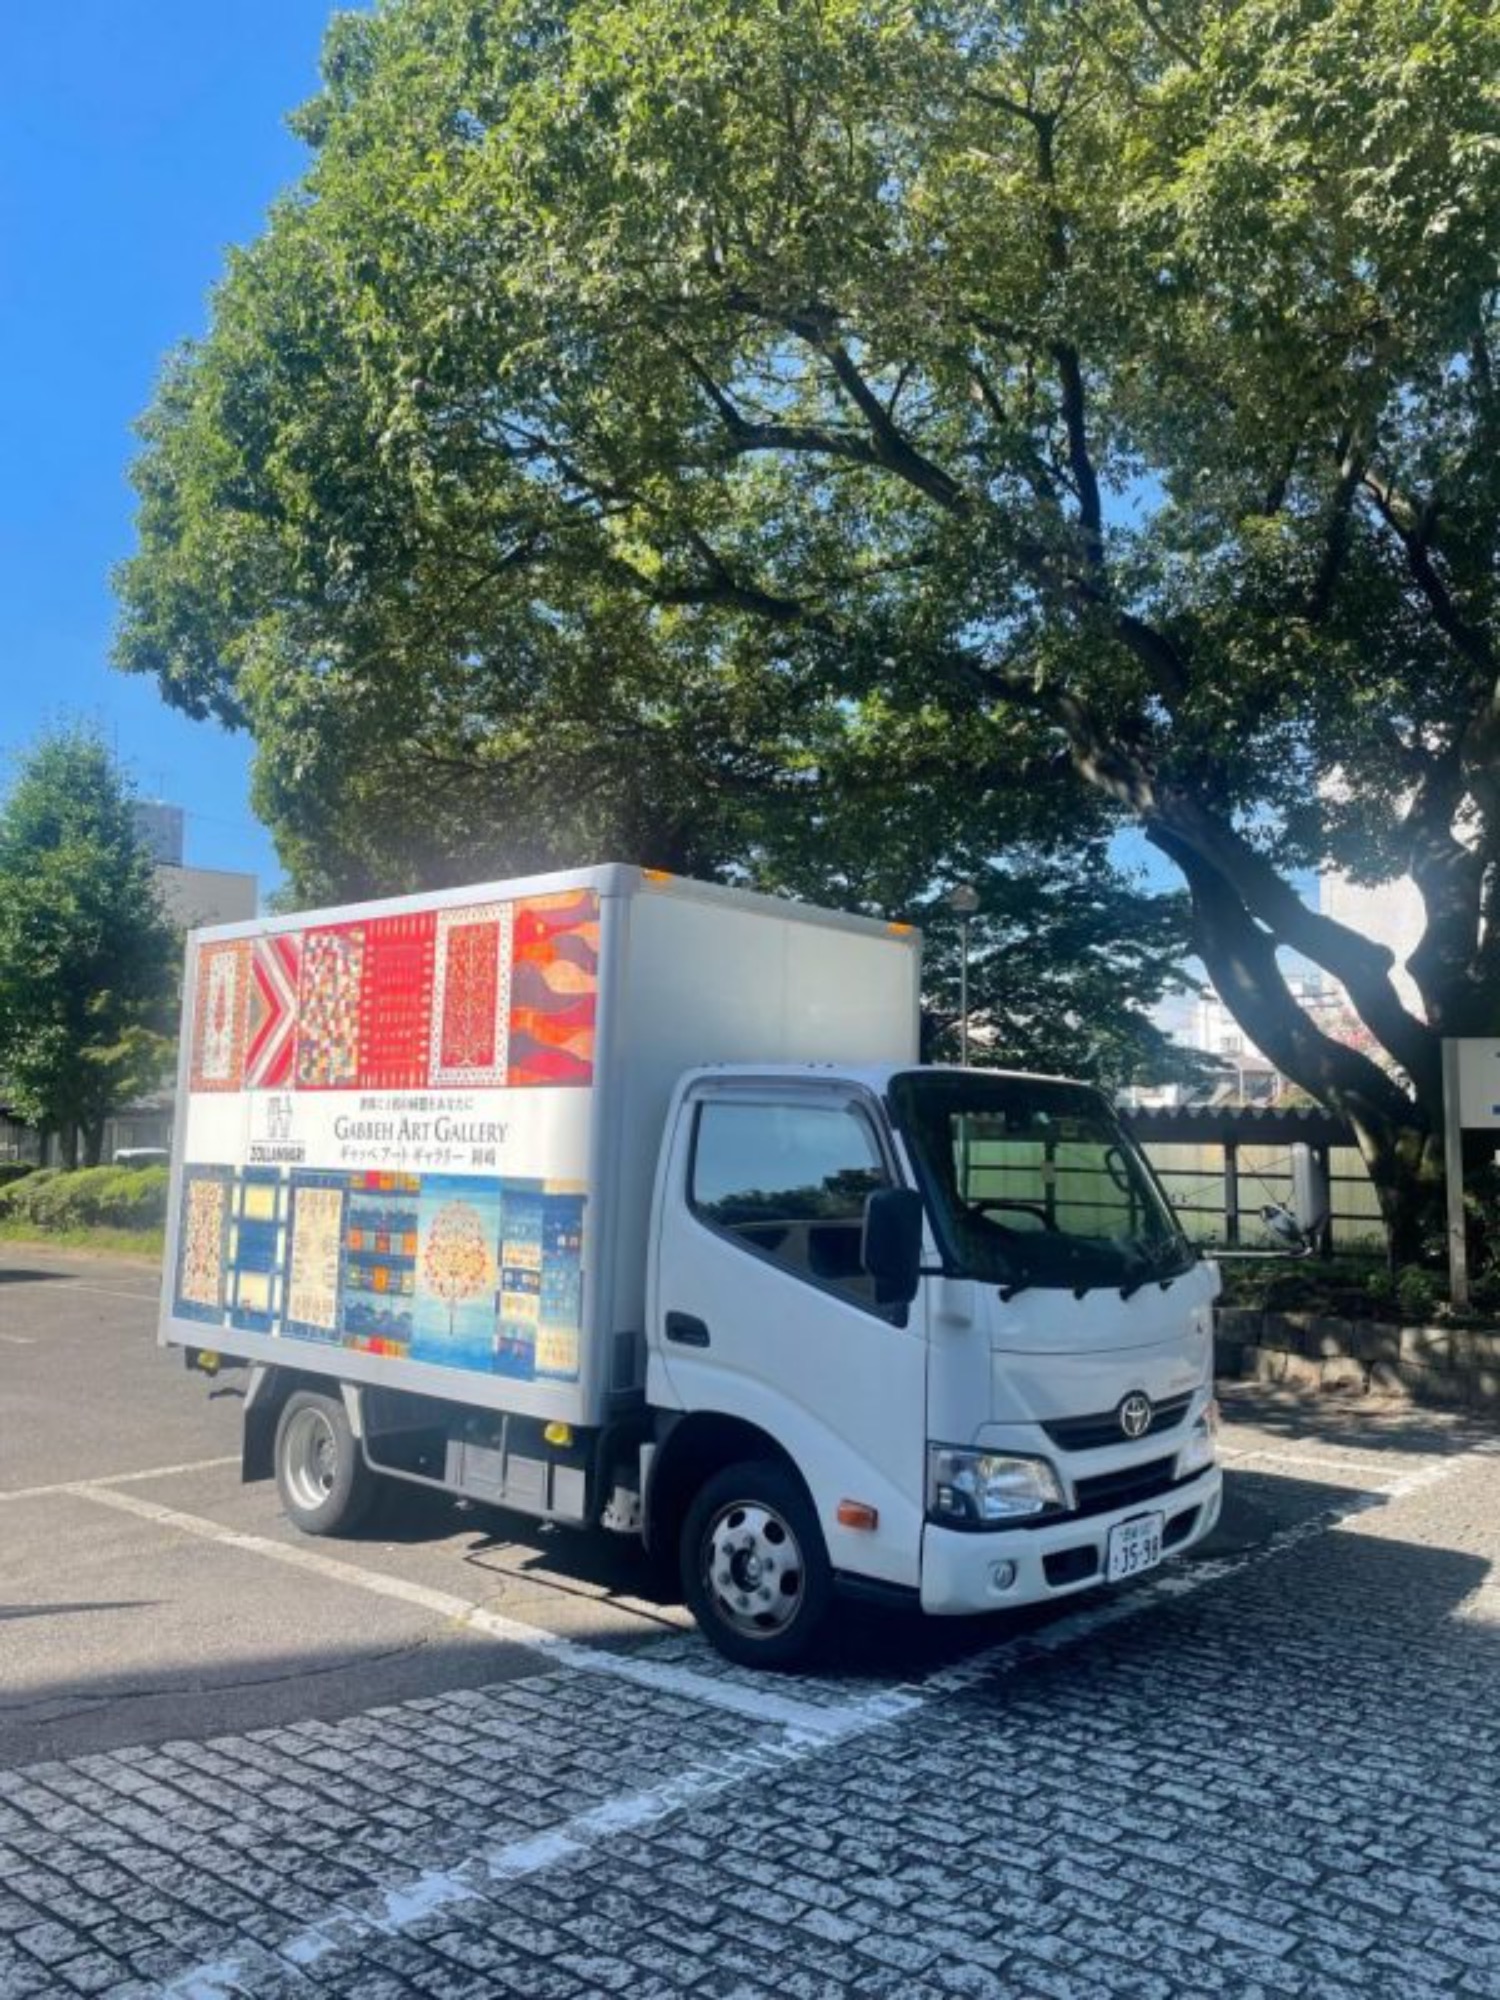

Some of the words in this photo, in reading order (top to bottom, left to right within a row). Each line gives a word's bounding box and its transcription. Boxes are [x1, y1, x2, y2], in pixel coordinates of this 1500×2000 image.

[334, 1115, 394, 1141] GABBEH
[397, 1117, 432, 1142] ART
[434, 1116, 508, 1144] GALLERY
